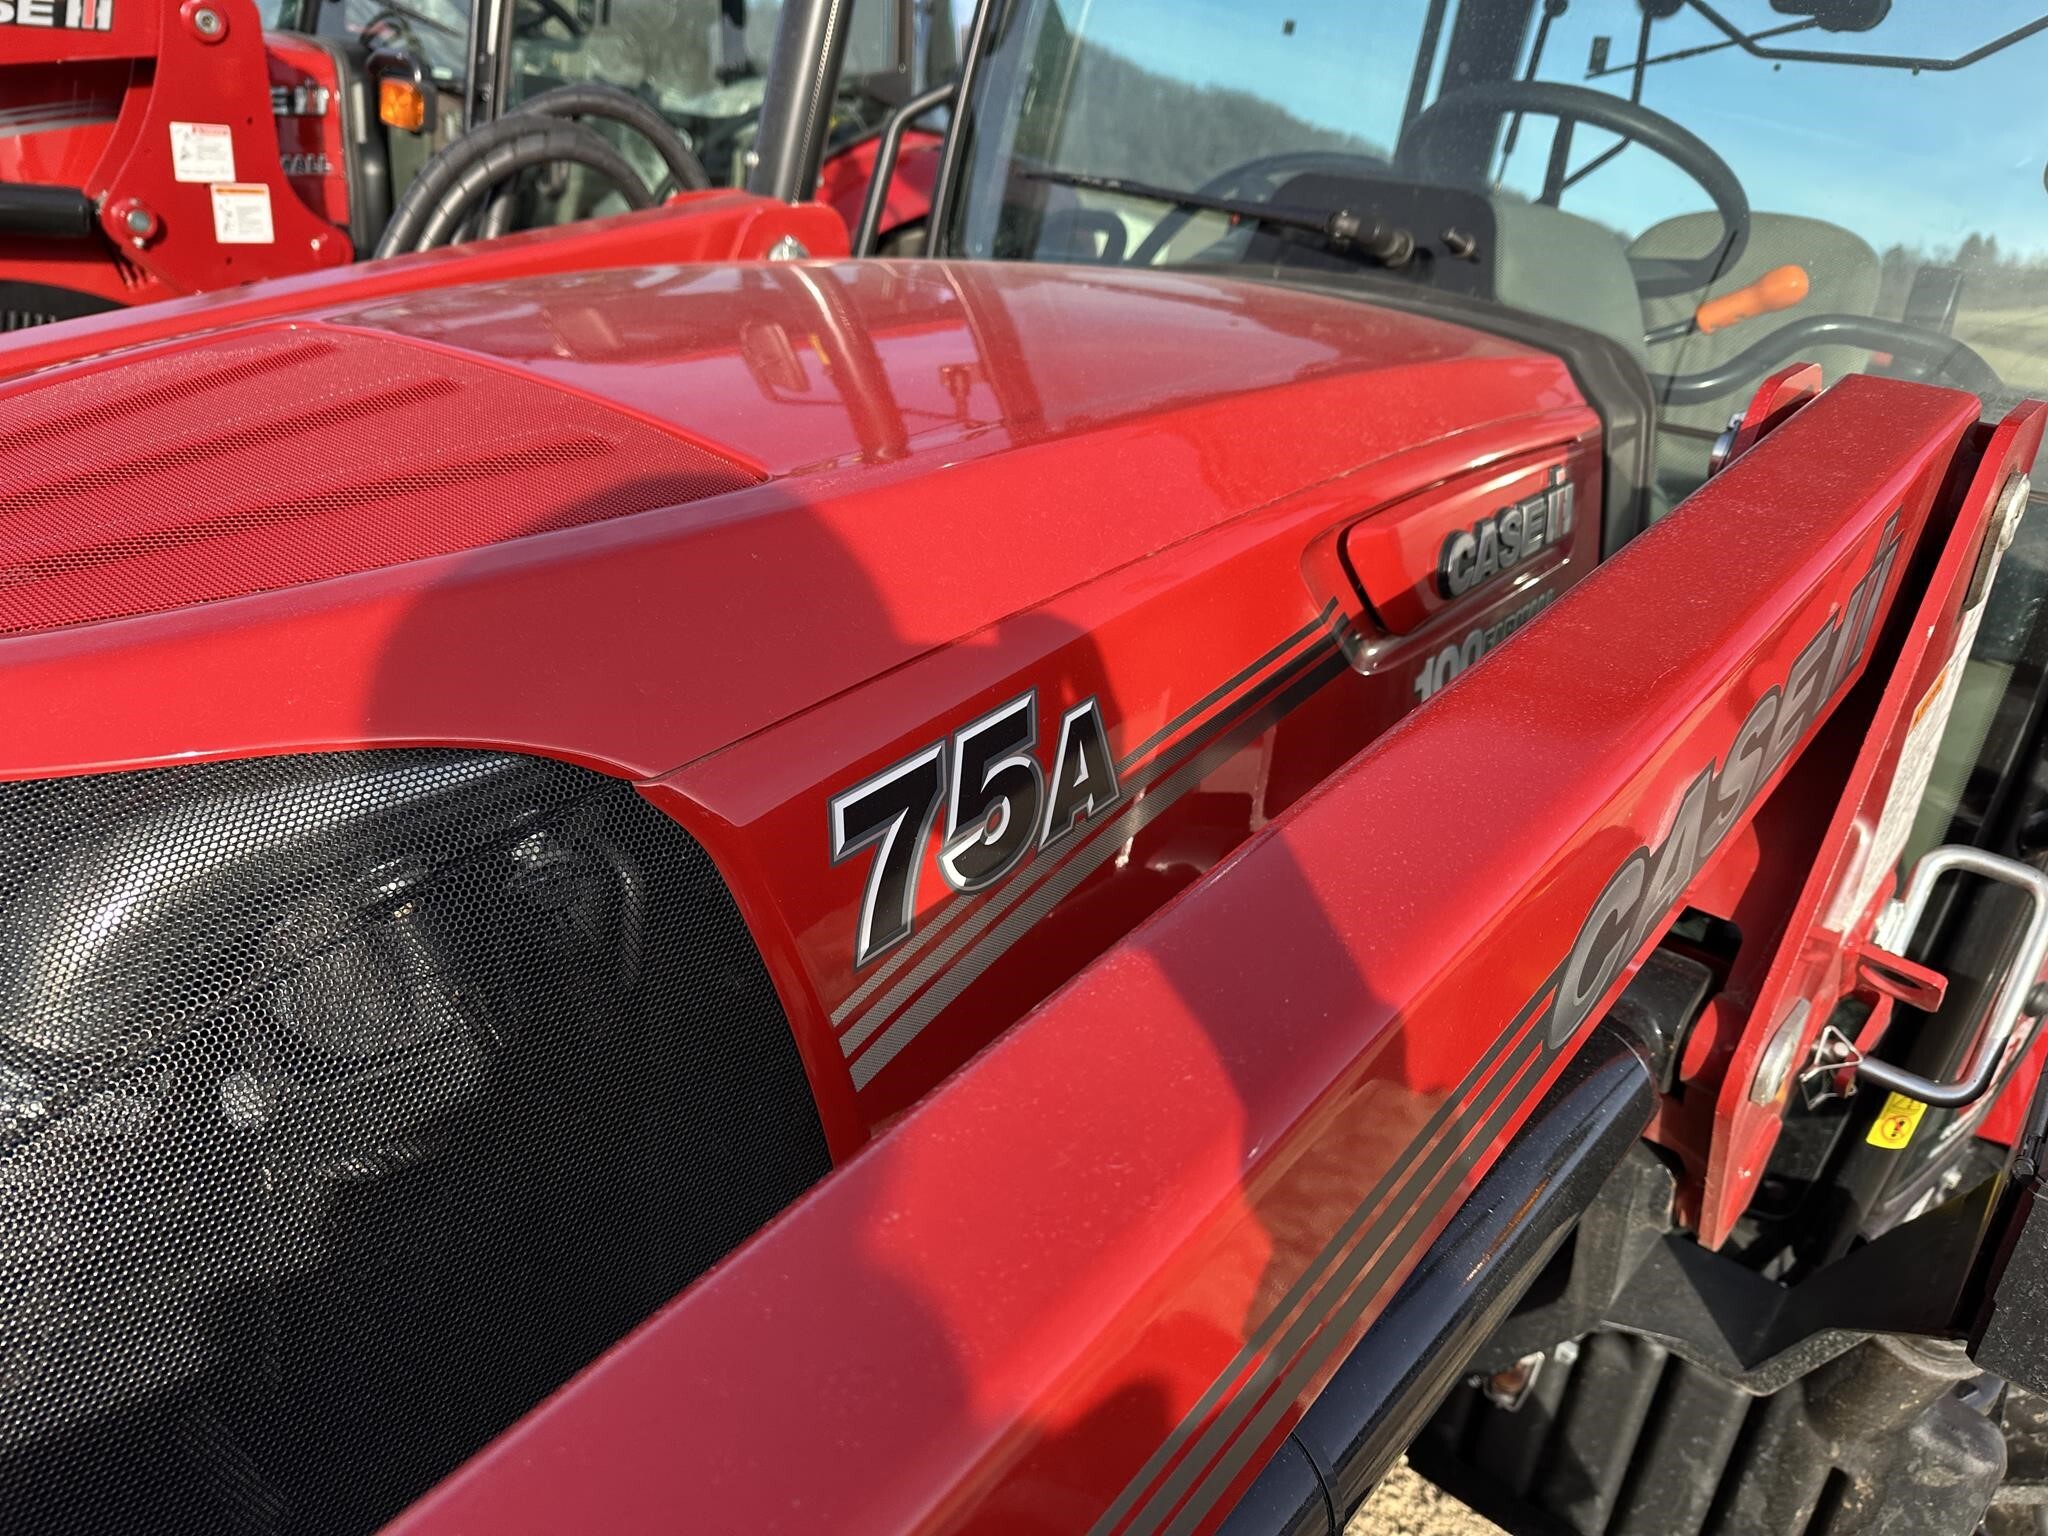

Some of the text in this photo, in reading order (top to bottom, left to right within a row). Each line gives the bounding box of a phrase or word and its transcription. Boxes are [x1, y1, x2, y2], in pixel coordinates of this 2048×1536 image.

[1438, 498, 1546, 598] CASE
[830, 688, 1119, 969] 75A
[1549, 614, 1837, 1050] CASE
